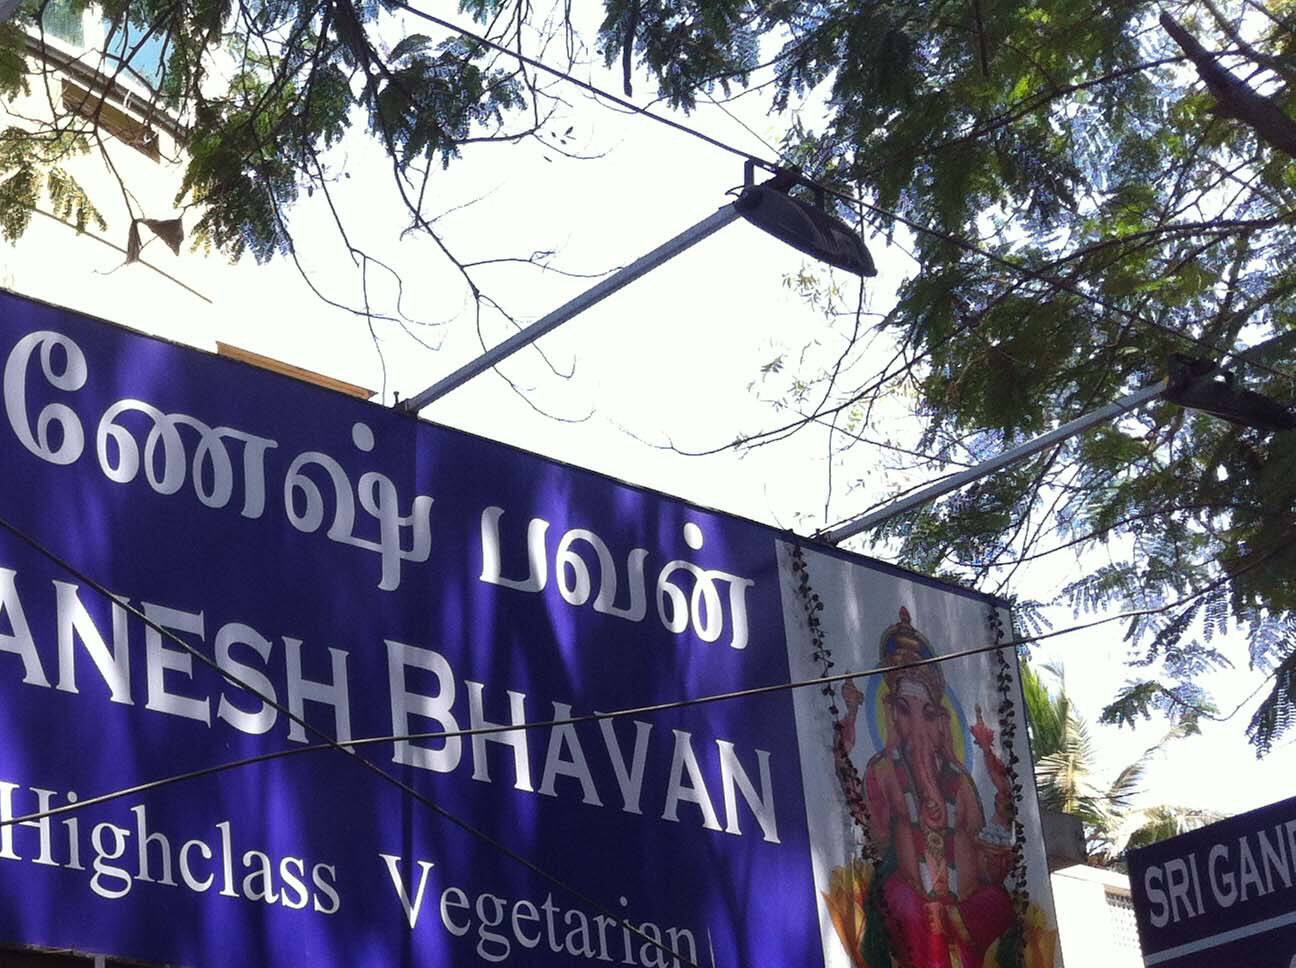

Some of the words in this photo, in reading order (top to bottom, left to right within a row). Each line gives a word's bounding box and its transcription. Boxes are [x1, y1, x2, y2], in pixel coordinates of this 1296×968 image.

[479, 506, 755, 650] பவன்
[384, 639, 781, 845] BHAVAN
[1144, 852, 1207, 929] SRI
